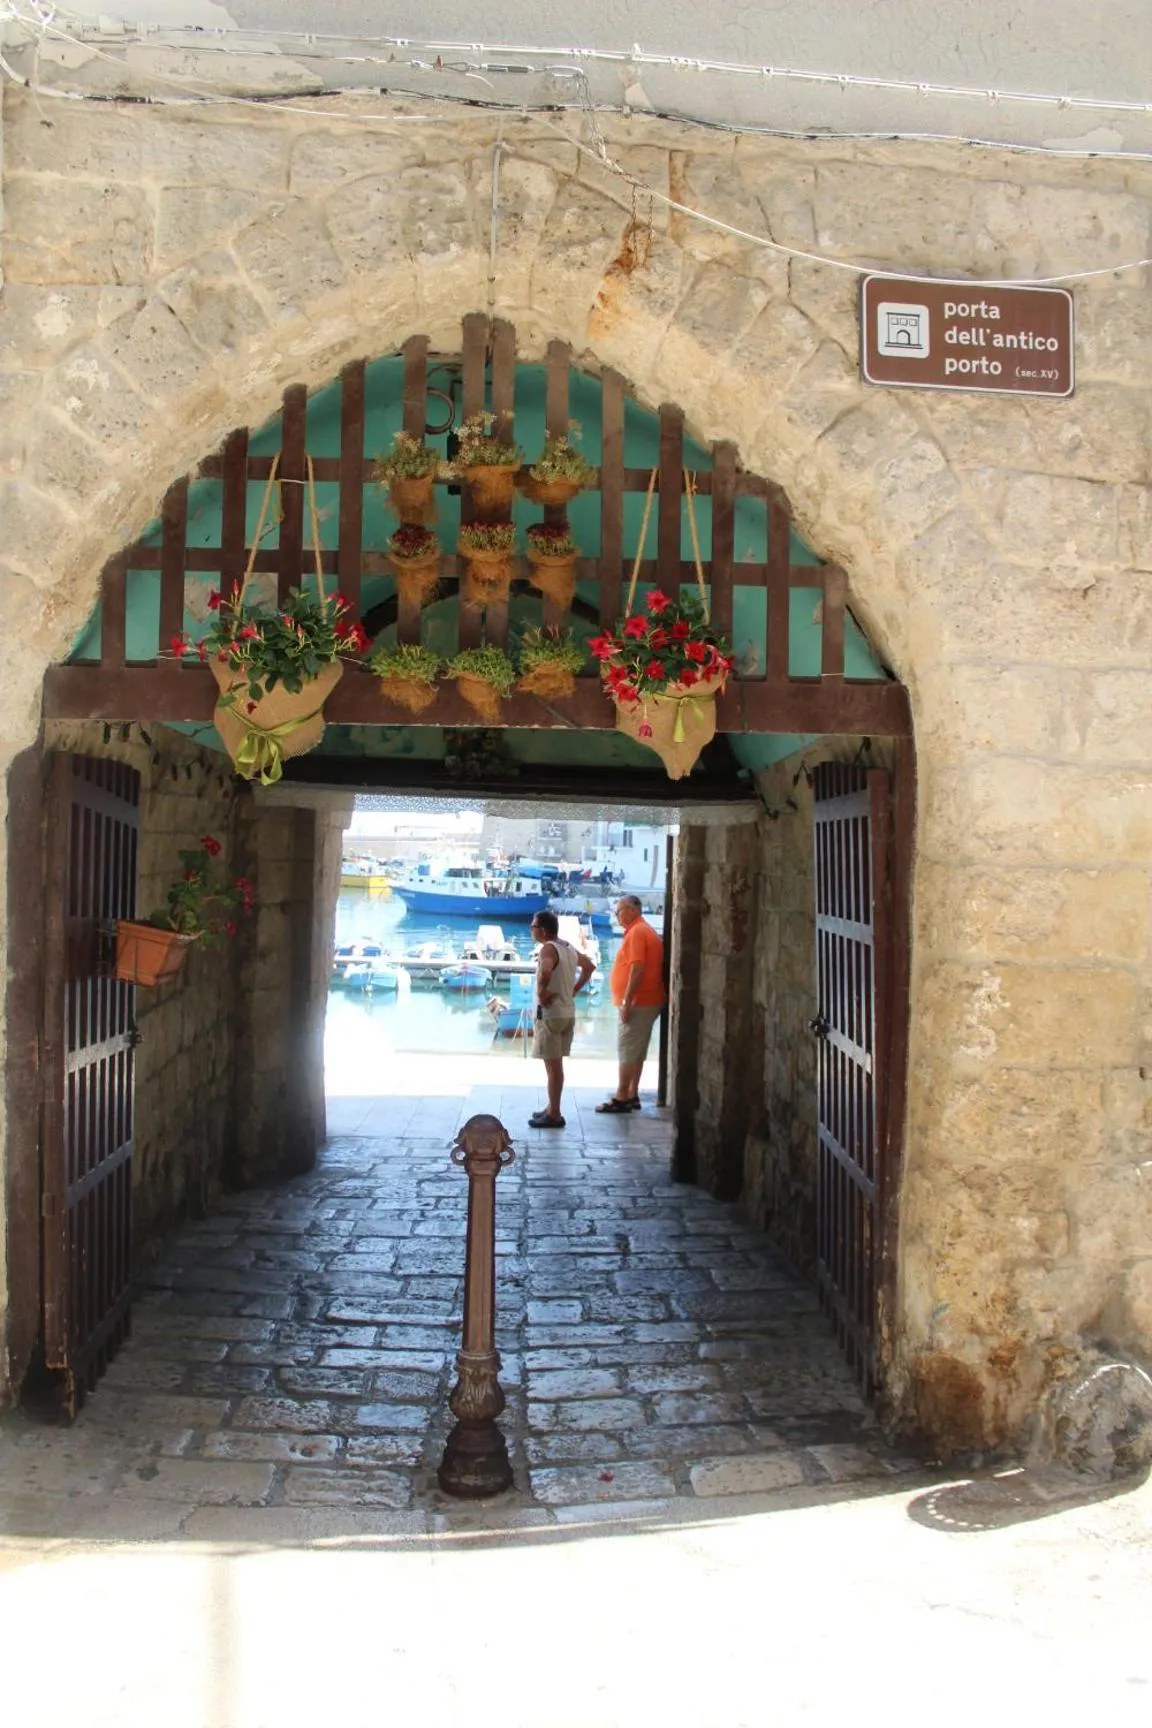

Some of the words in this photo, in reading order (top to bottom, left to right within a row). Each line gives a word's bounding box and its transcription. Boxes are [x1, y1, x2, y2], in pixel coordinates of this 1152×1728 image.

[944, 301, 1001, 319] porta
[944, 326, 1059, 351] dell'antico
[945, 356, 1002, 375] porto
